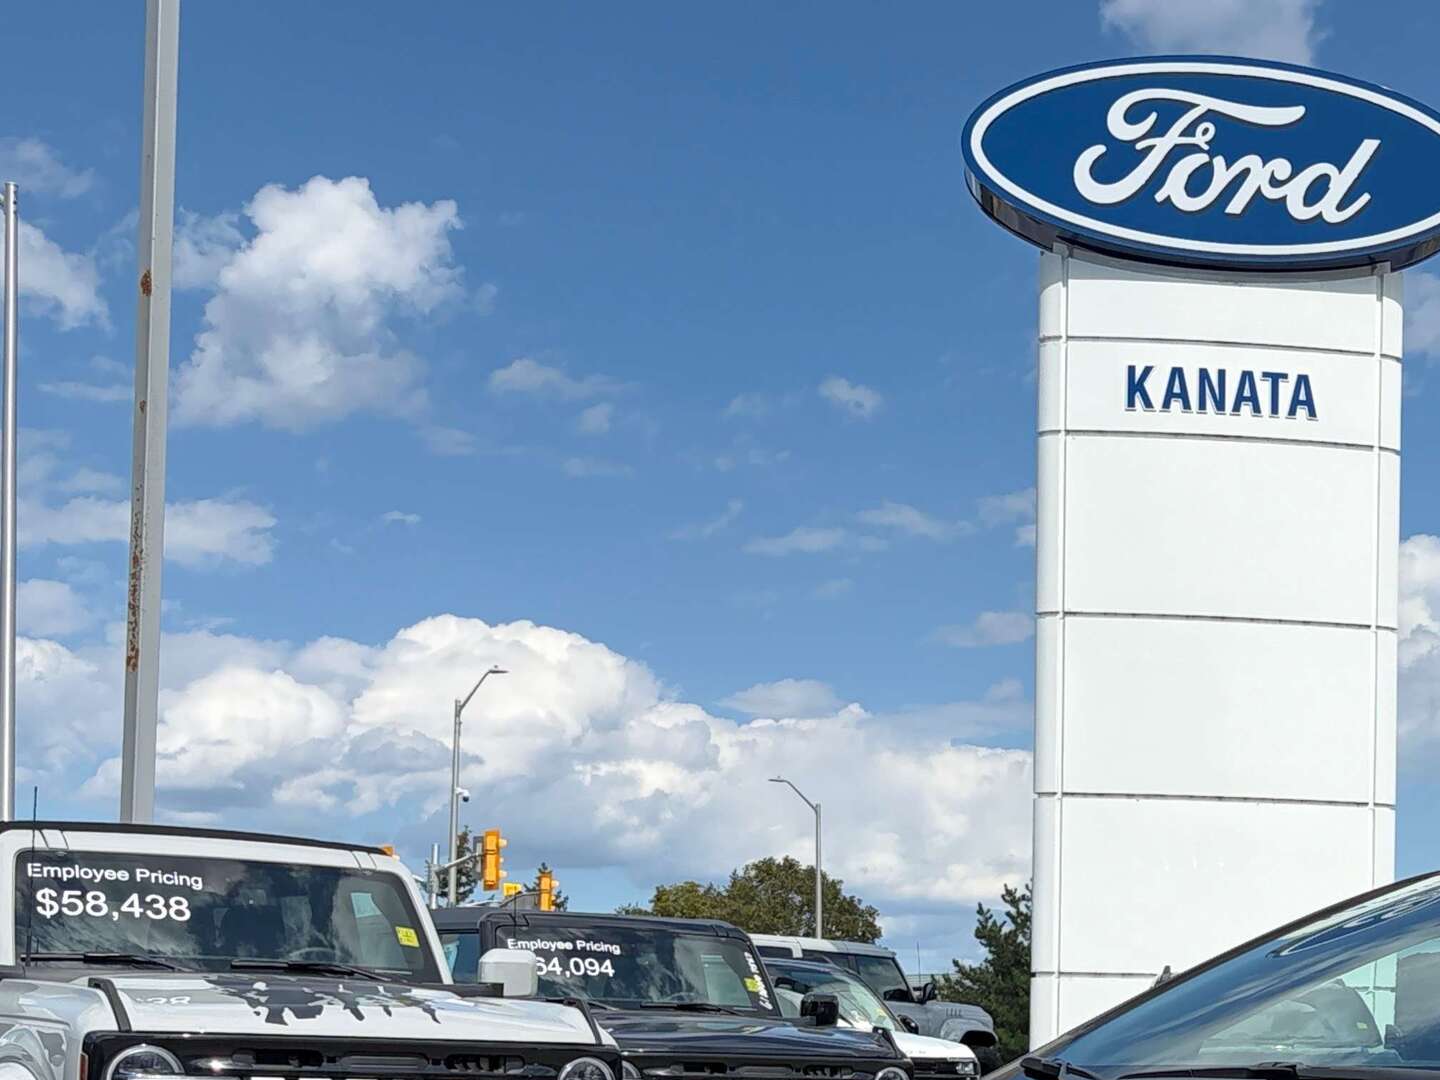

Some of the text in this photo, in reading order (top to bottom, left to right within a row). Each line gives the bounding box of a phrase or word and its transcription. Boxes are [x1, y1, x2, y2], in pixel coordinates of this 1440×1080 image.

[1073, 88, 1381, 223] Ford
[1125, 364, 1318, 420] KANATA
[27, 863, 203, 891] Employee Pricing
[35, 887, 192, 922] $58,438
[506, 938, 621, 955] Employee Pricing
[535, 956, 616, 978] 64,094
